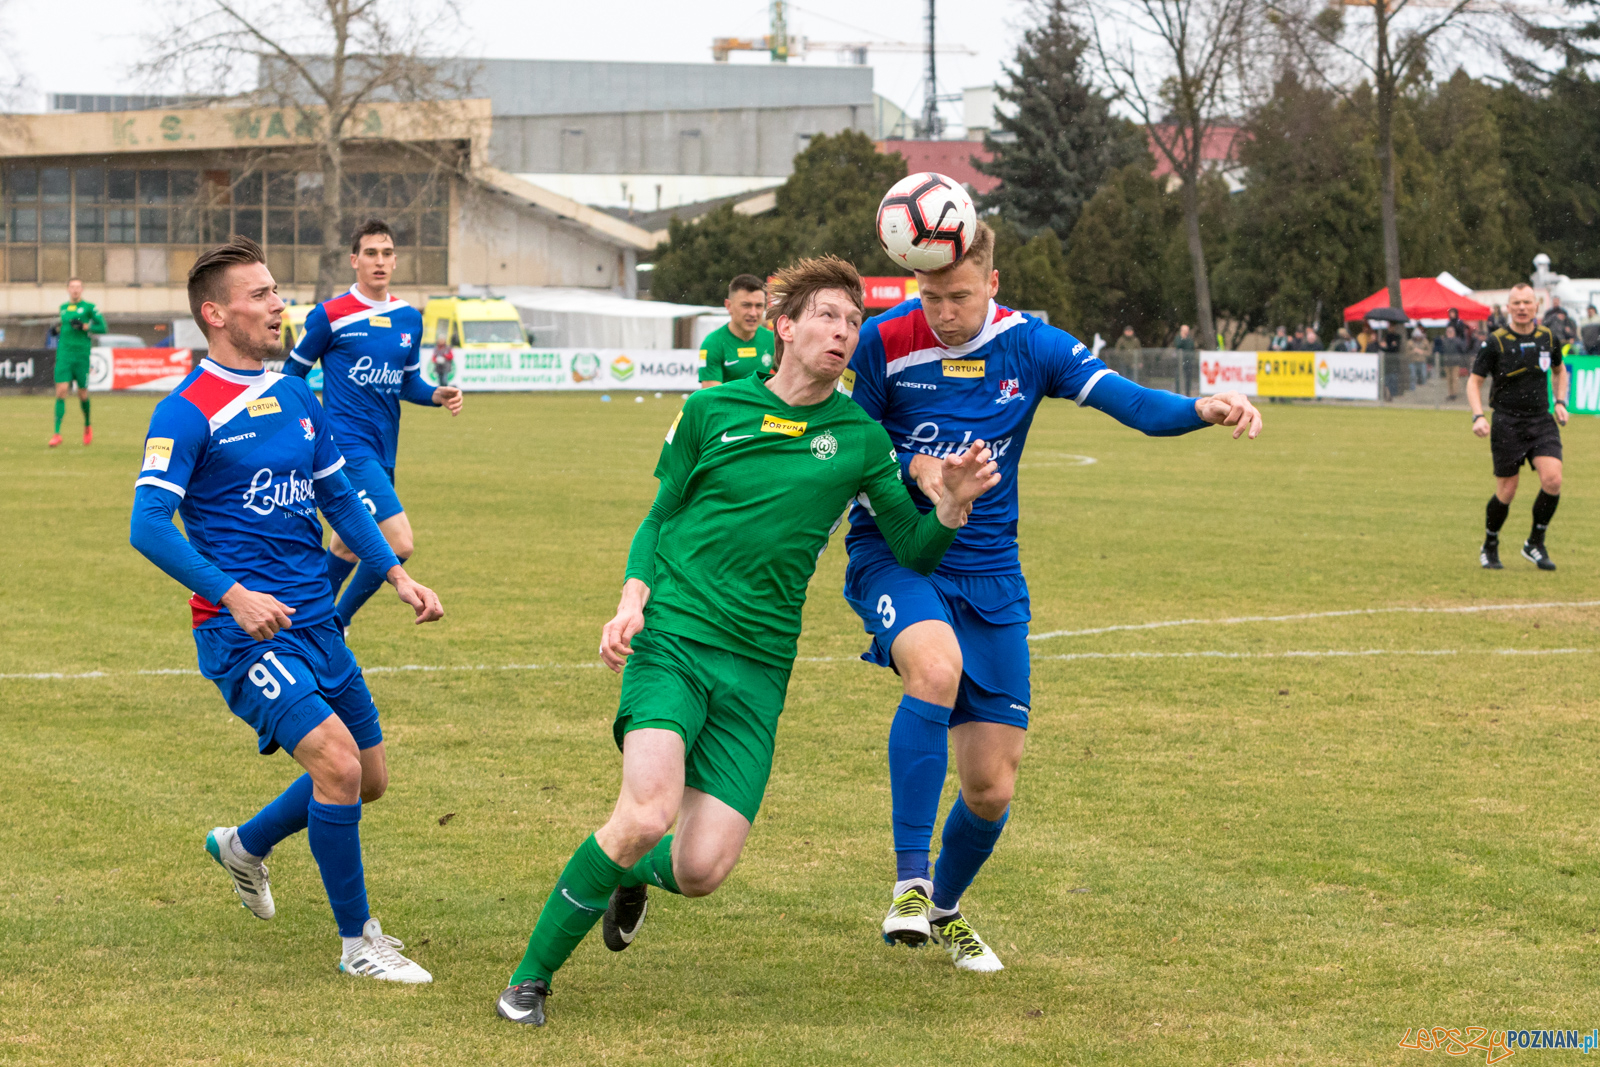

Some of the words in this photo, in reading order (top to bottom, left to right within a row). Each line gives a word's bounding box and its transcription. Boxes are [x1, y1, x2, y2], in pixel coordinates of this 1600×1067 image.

[520, 353, 562, 369] STREFA
[1258, 360, 1314, 376] FORTUNA
[943, 365, 984, 373] FORTUNA
[1333, 367, 1378, 382] MAGMAR
[248, 401, 279, 413] FORTUNA
[763, 420, 804, 433] FORTUNA
[877, 593, 896, 629] 3
[247, 650, 297, 700] 91
